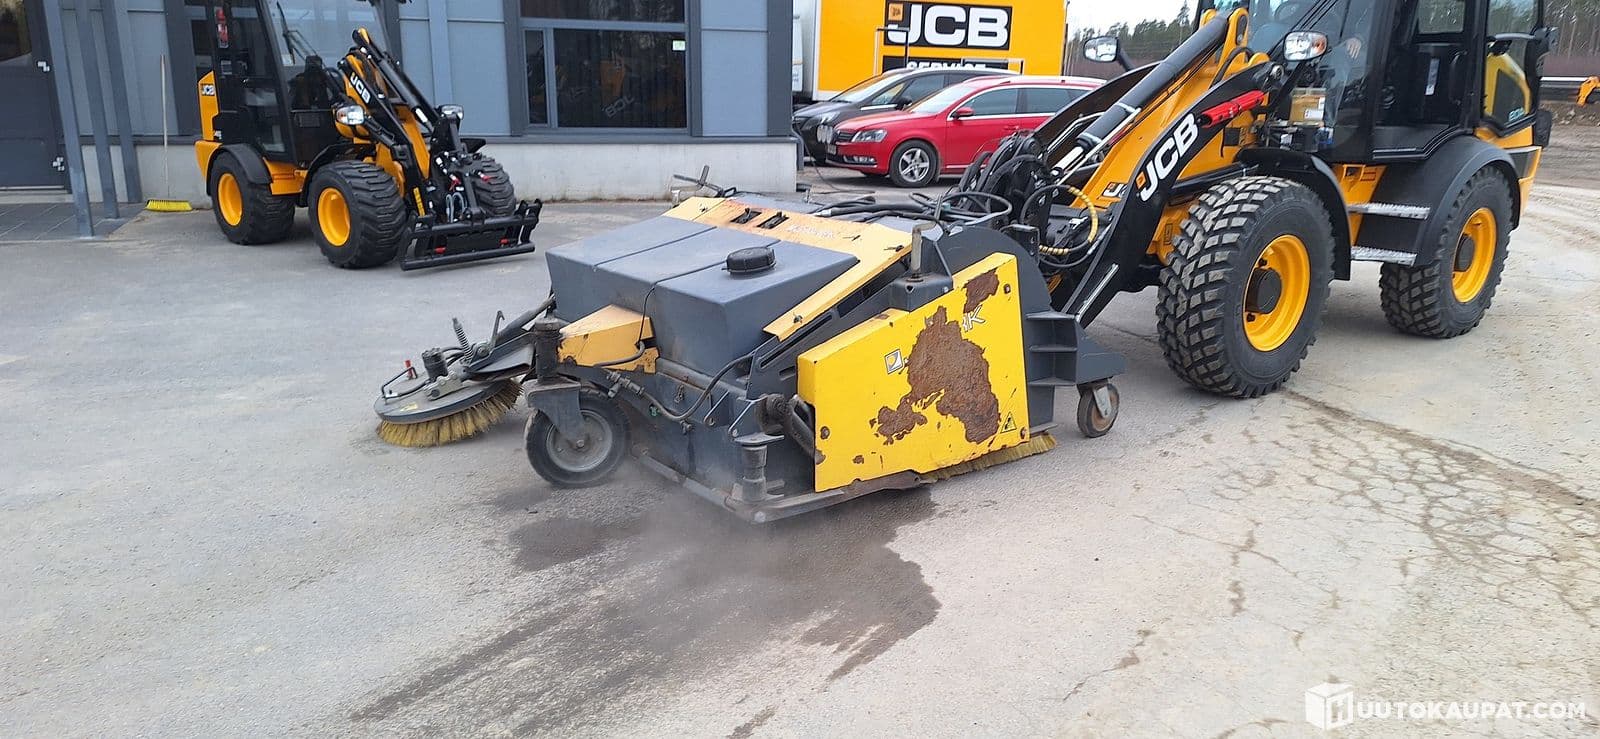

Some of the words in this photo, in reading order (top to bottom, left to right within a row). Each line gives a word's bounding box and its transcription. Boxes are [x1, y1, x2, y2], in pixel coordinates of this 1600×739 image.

[887, 3, 1009, 47] JCB
[350, 71, 371, 104] JCB
[1140, 113, 1199, 202] JCB
